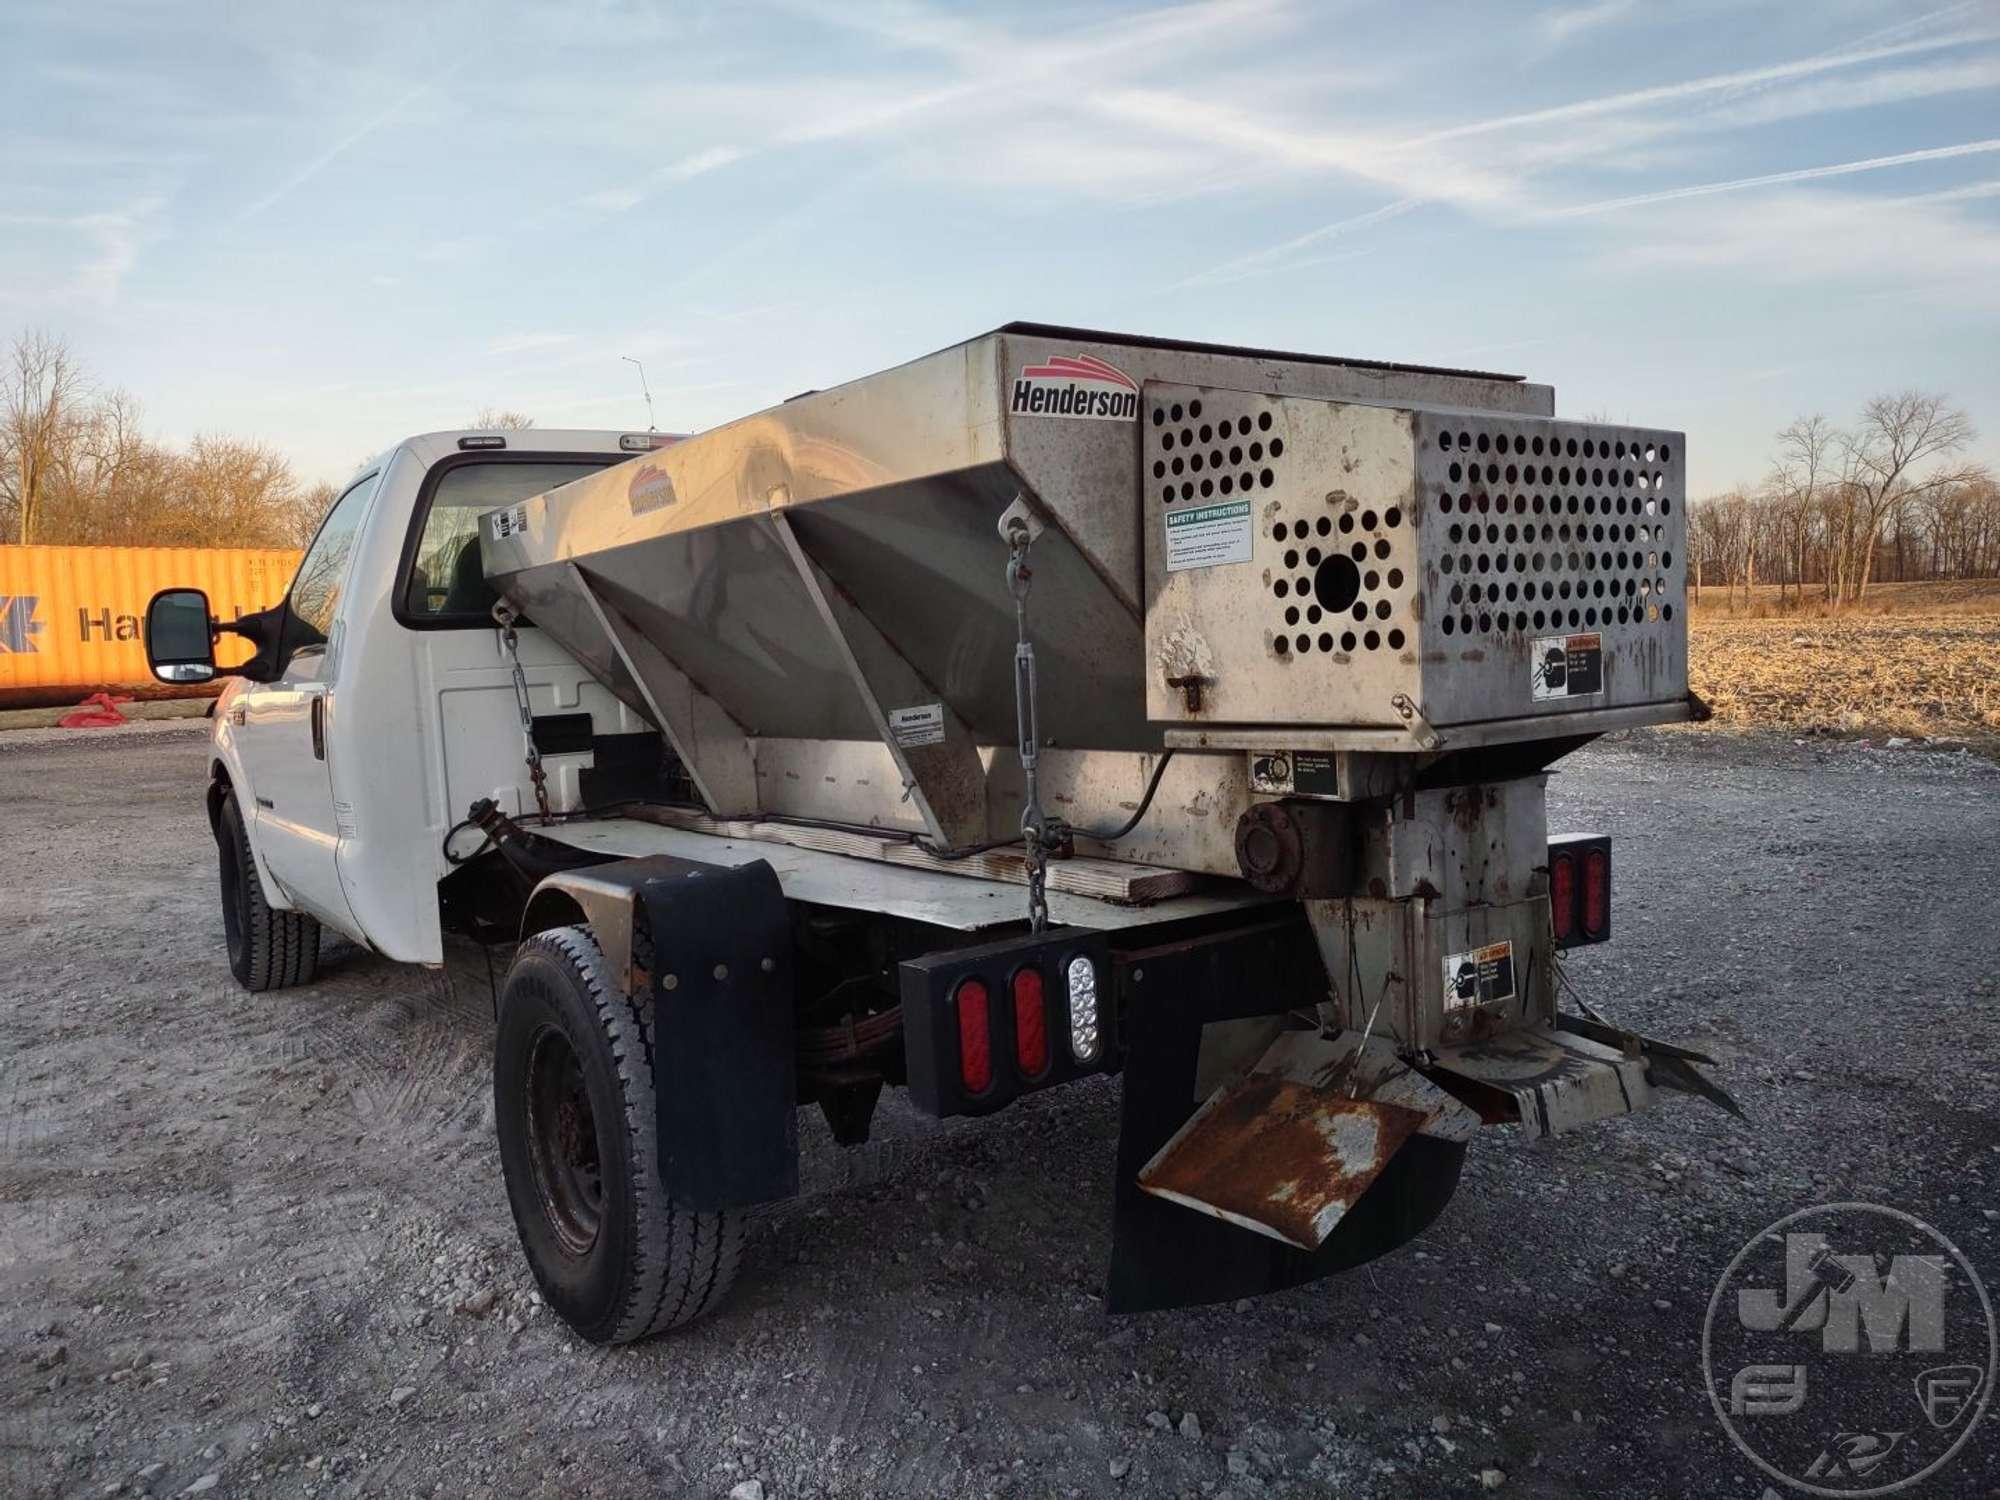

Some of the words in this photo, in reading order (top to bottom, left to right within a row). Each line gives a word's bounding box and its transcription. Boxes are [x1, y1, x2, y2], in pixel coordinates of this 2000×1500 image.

[1012, 380, 1136, 417] Henderson
[1168, 513, 1195, 525] SAFETY
[1196, 504, 1249, 520] INSTRUCTIONS
